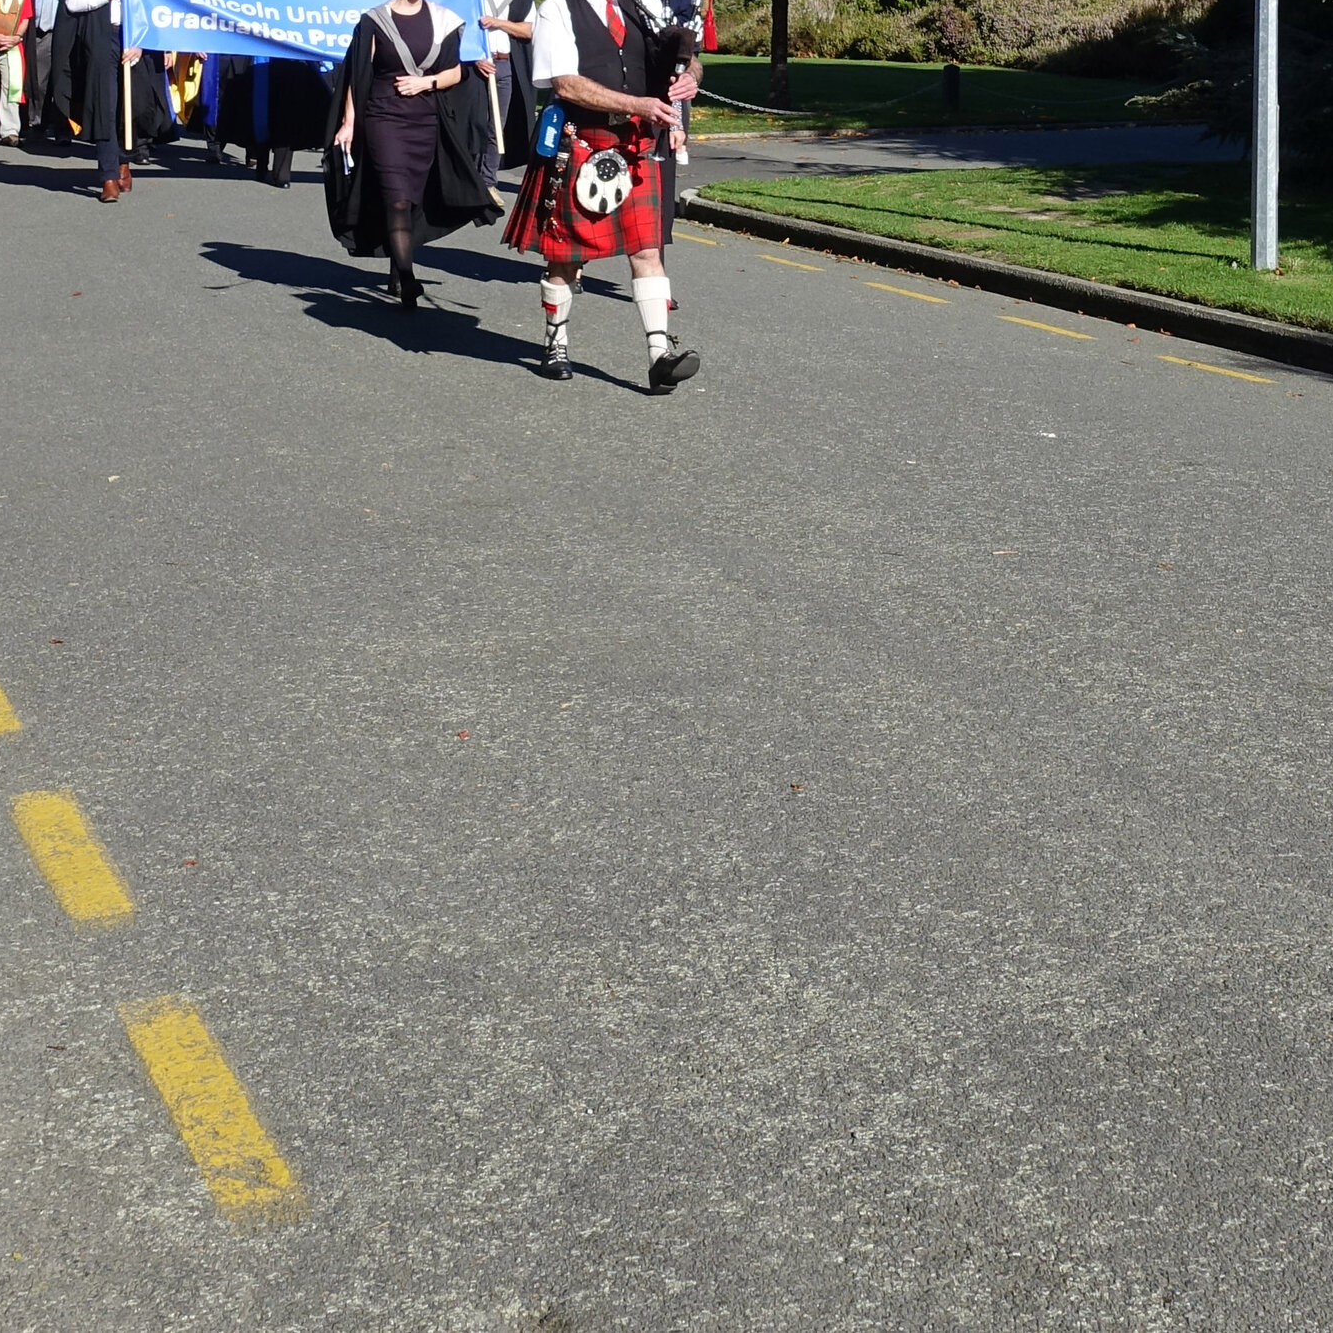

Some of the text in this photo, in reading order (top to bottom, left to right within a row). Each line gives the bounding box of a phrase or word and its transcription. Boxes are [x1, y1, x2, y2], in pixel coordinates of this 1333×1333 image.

[151, 5, 354, 48] Graduation Pro
[286, 5, 370, 25] Unive
